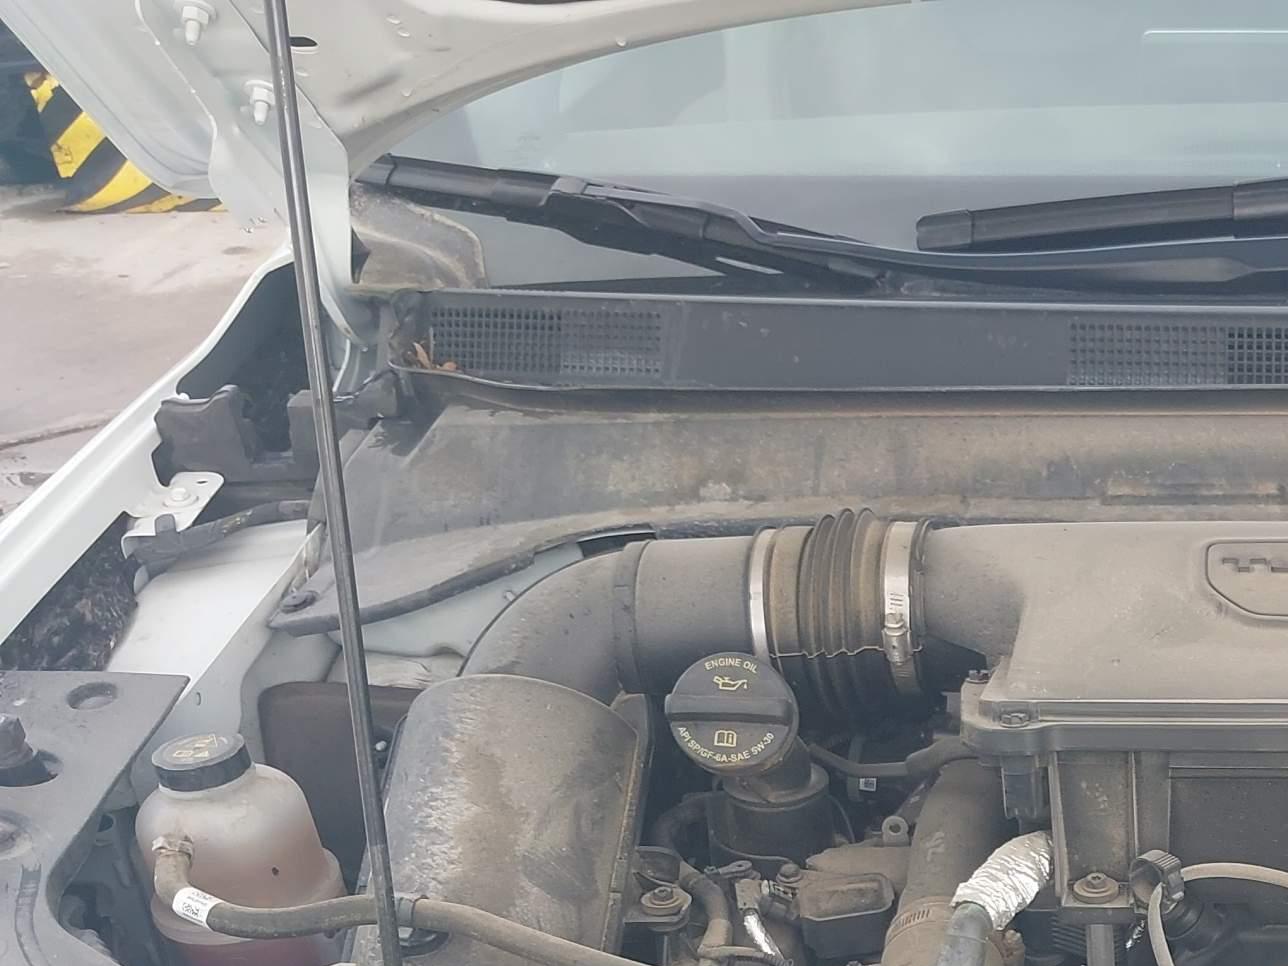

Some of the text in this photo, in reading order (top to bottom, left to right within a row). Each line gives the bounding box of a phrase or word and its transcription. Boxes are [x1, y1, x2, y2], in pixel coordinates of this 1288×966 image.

[704, 657, 758, 674] ENGINE OIL
[677, 726, 690, 742] API
[751, 731, 775, 756] 5W-30
